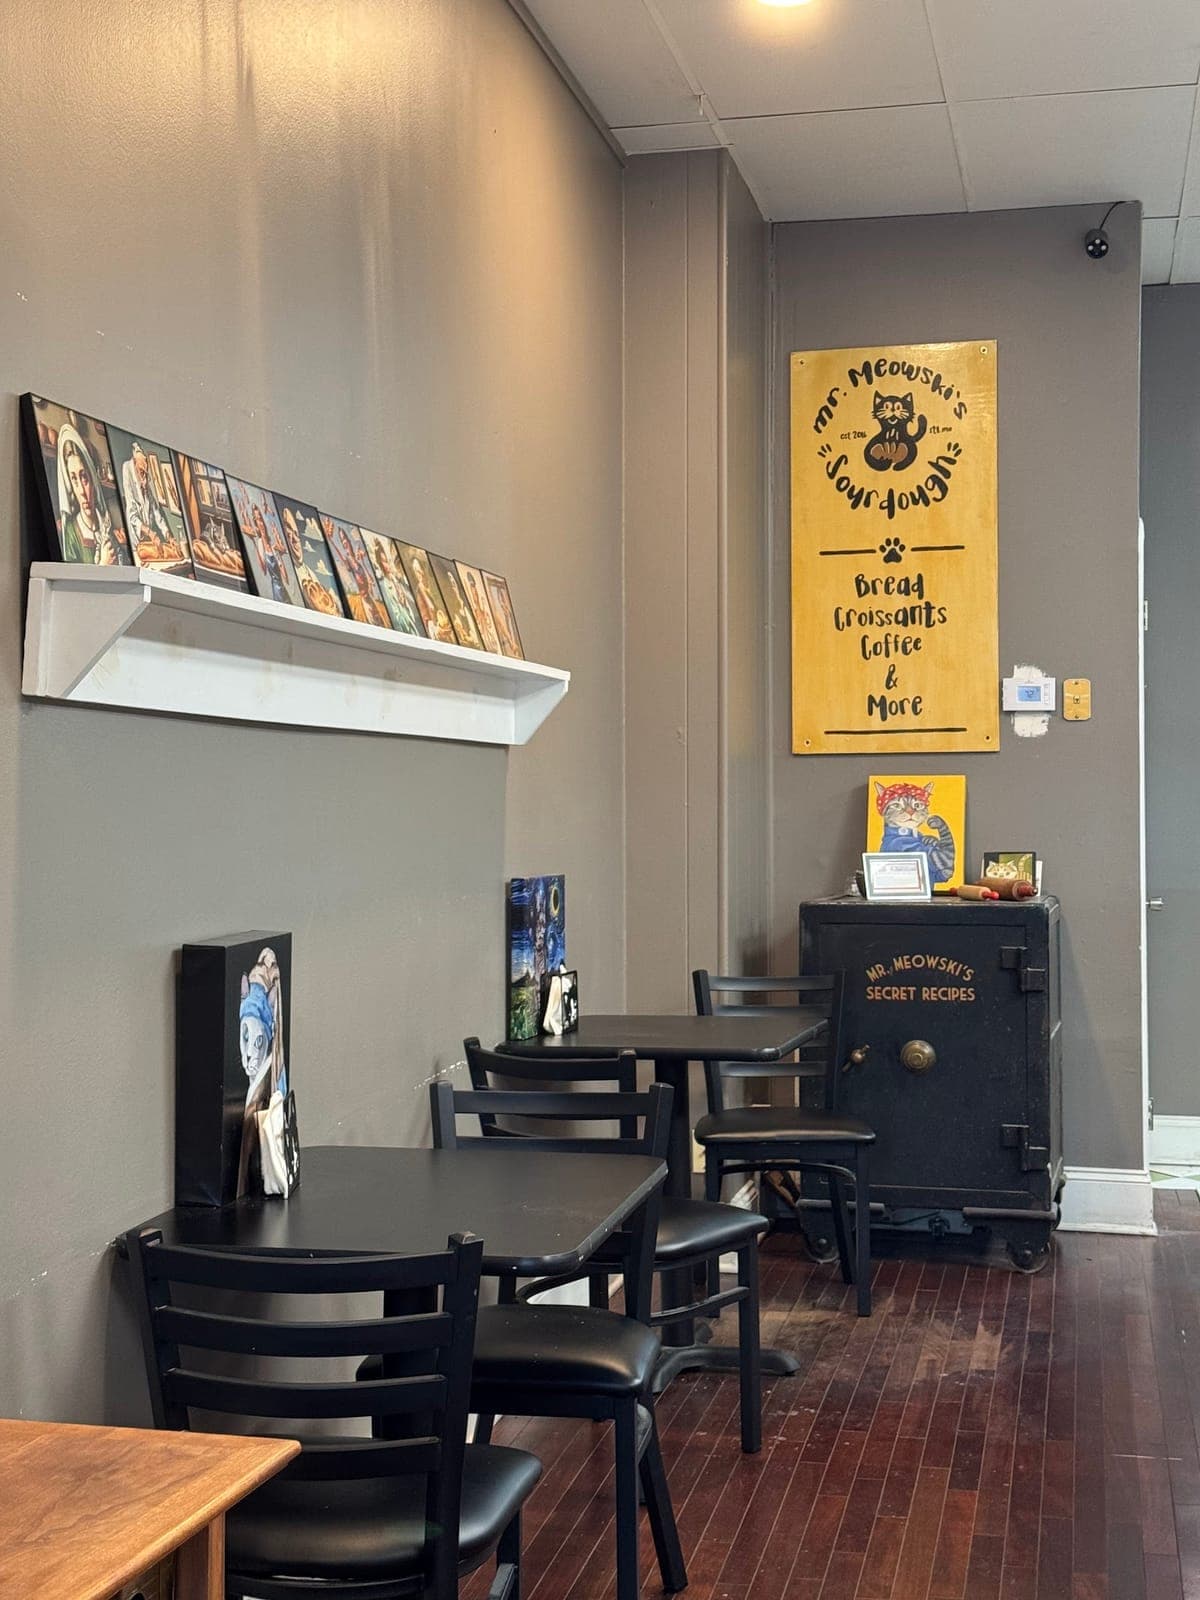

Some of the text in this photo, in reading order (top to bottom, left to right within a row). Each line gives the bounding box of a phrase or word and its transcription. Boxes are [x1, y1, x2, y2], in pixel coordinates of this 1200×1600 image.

[848, 358, 968, 420] Meowski's
[855, 573, 924, 600] Bread
[834, 601, 947, 631] Croissants
[861, 633, 922, 660] Coffee
[885, 664, 898, 690] &
[867, 694, 923, 722] More
[866, 954, 975, 982] MR. MEOWSKI'S
[866, 986, 976, 1002] SECRET RECIPES
